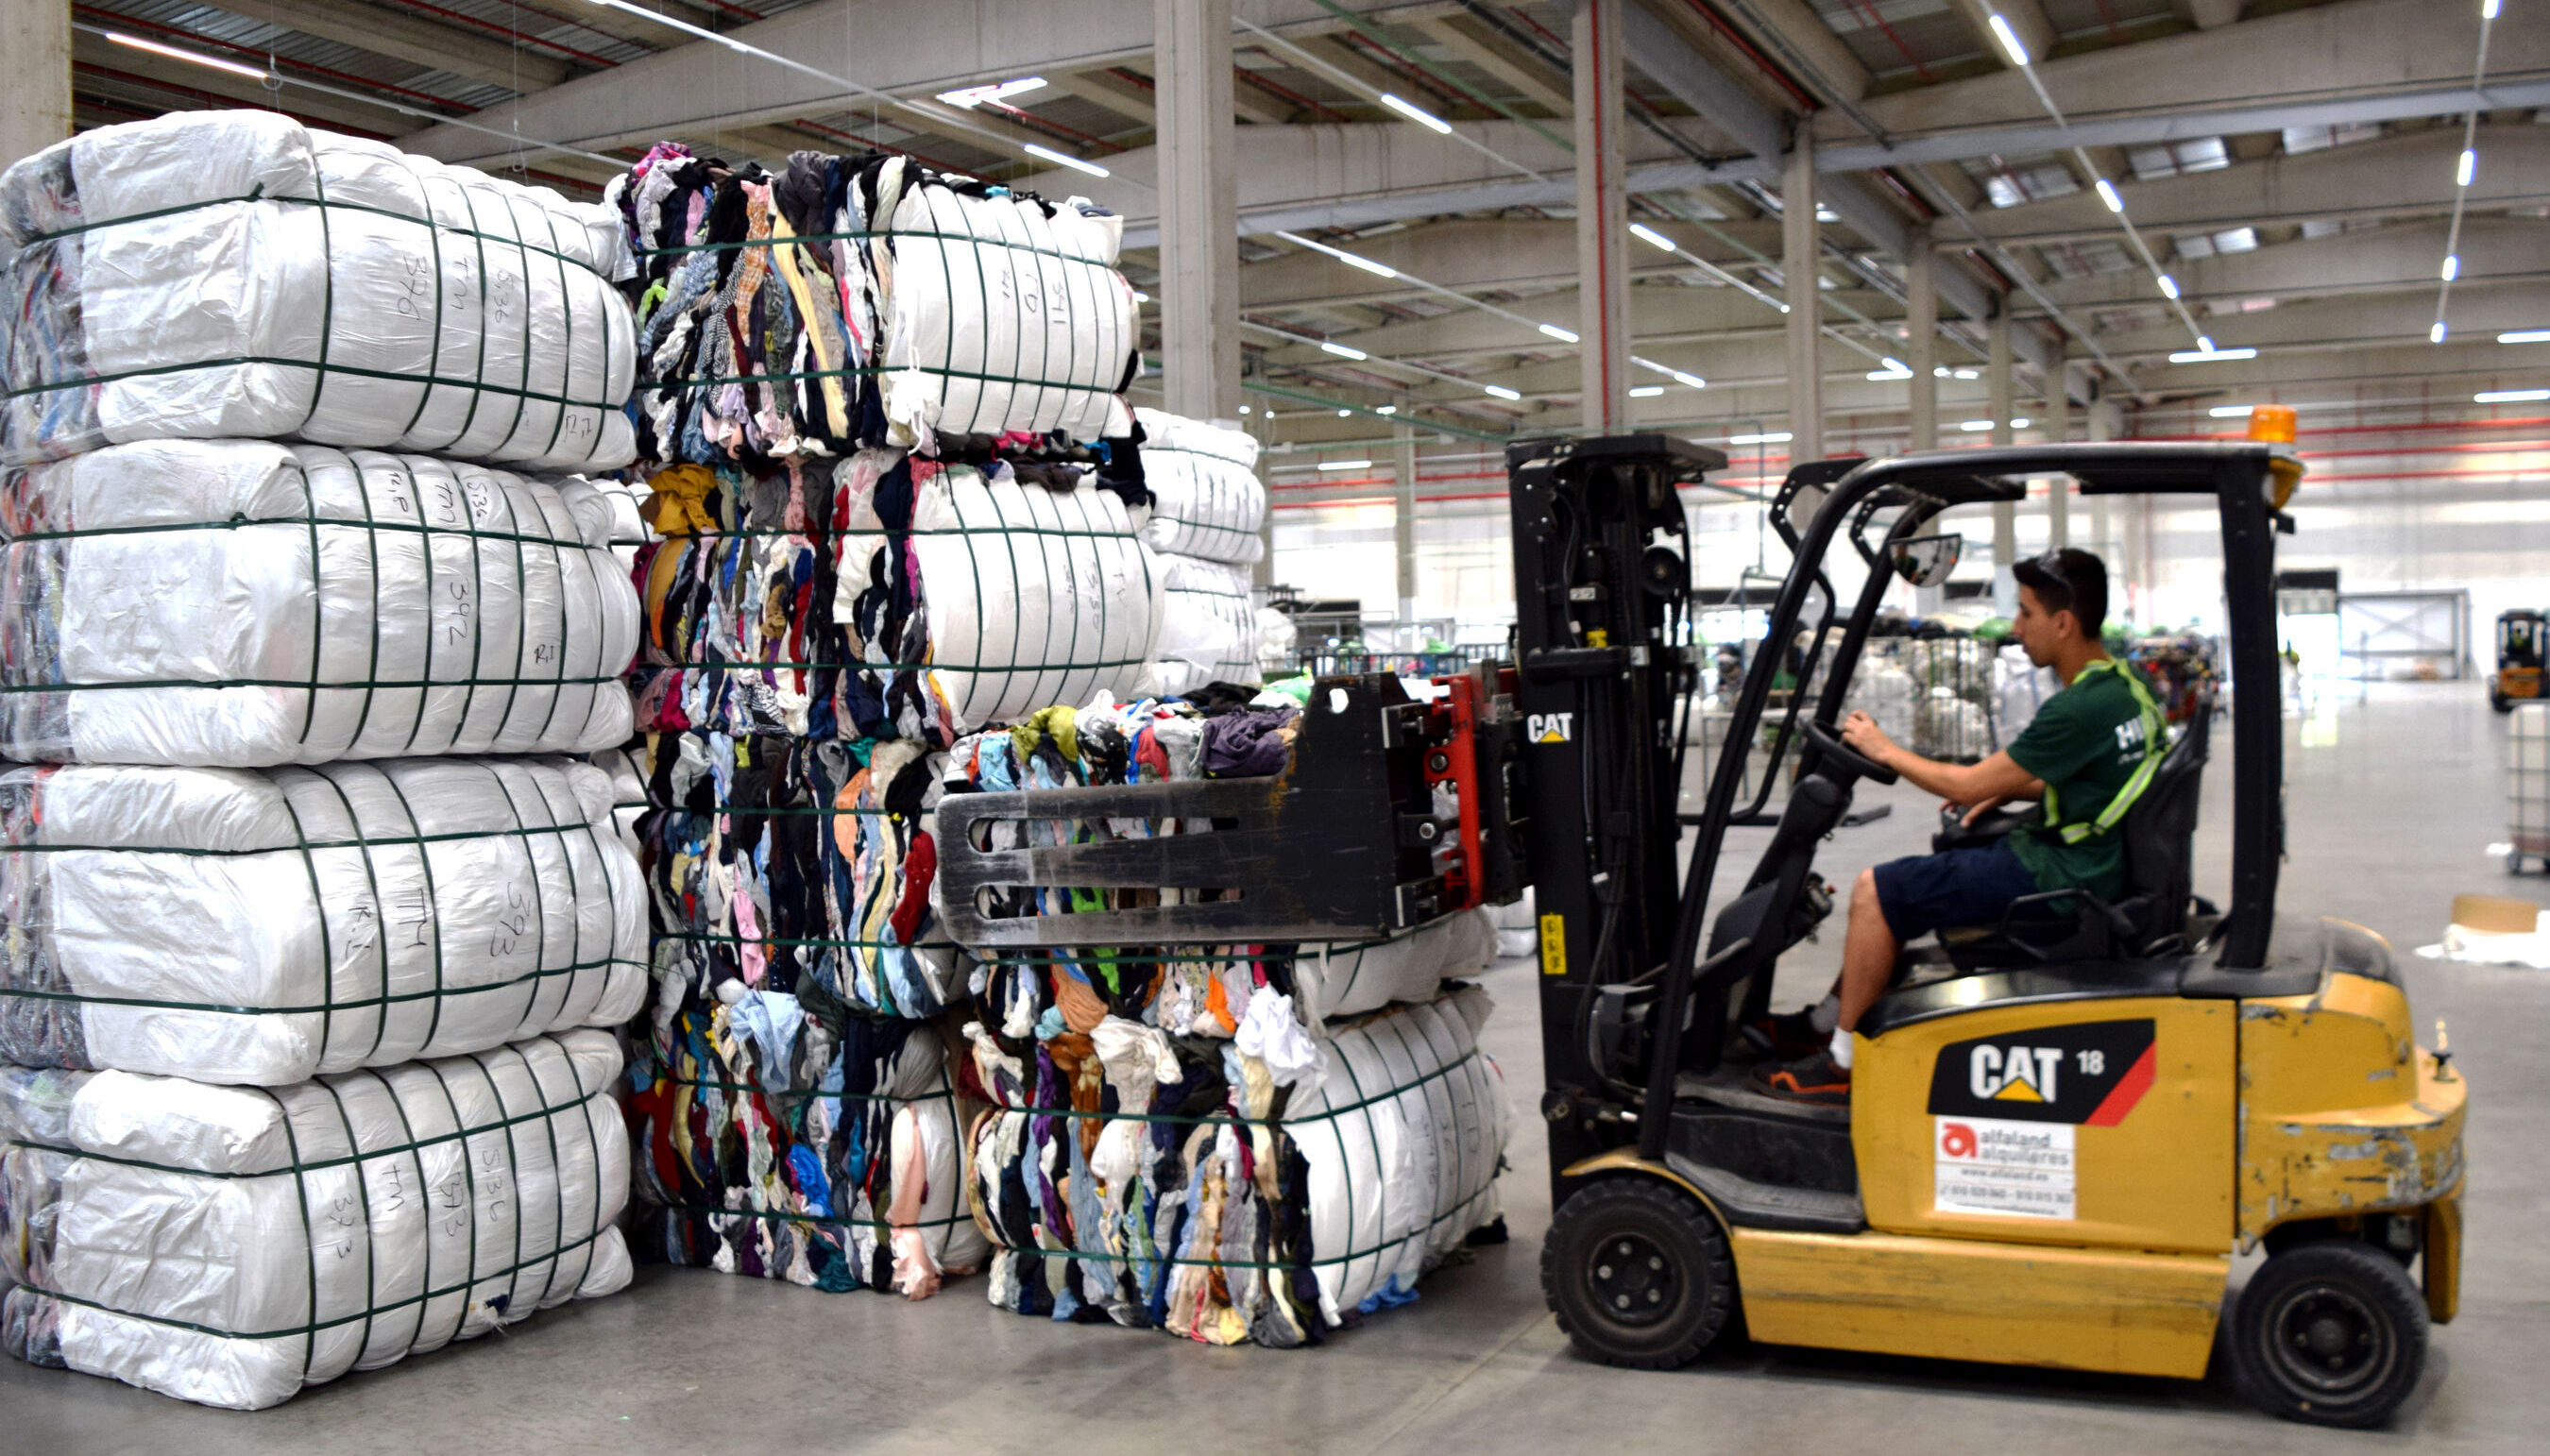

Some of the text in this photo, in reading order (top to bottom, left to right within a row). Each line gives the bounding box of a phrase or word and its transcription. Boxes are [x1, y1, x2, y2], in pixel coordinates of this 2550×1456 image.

[449, 577, 471, 647] 392
[1527, 713, 1573, 743] CAT
[490, 882, 531, 957] 393
[1970, 1044, 2105, 1104] CAT 18
[1980, 1129, 2051, 1149] alfaland
[1981, 1145, 2069, 1165] alquileres
